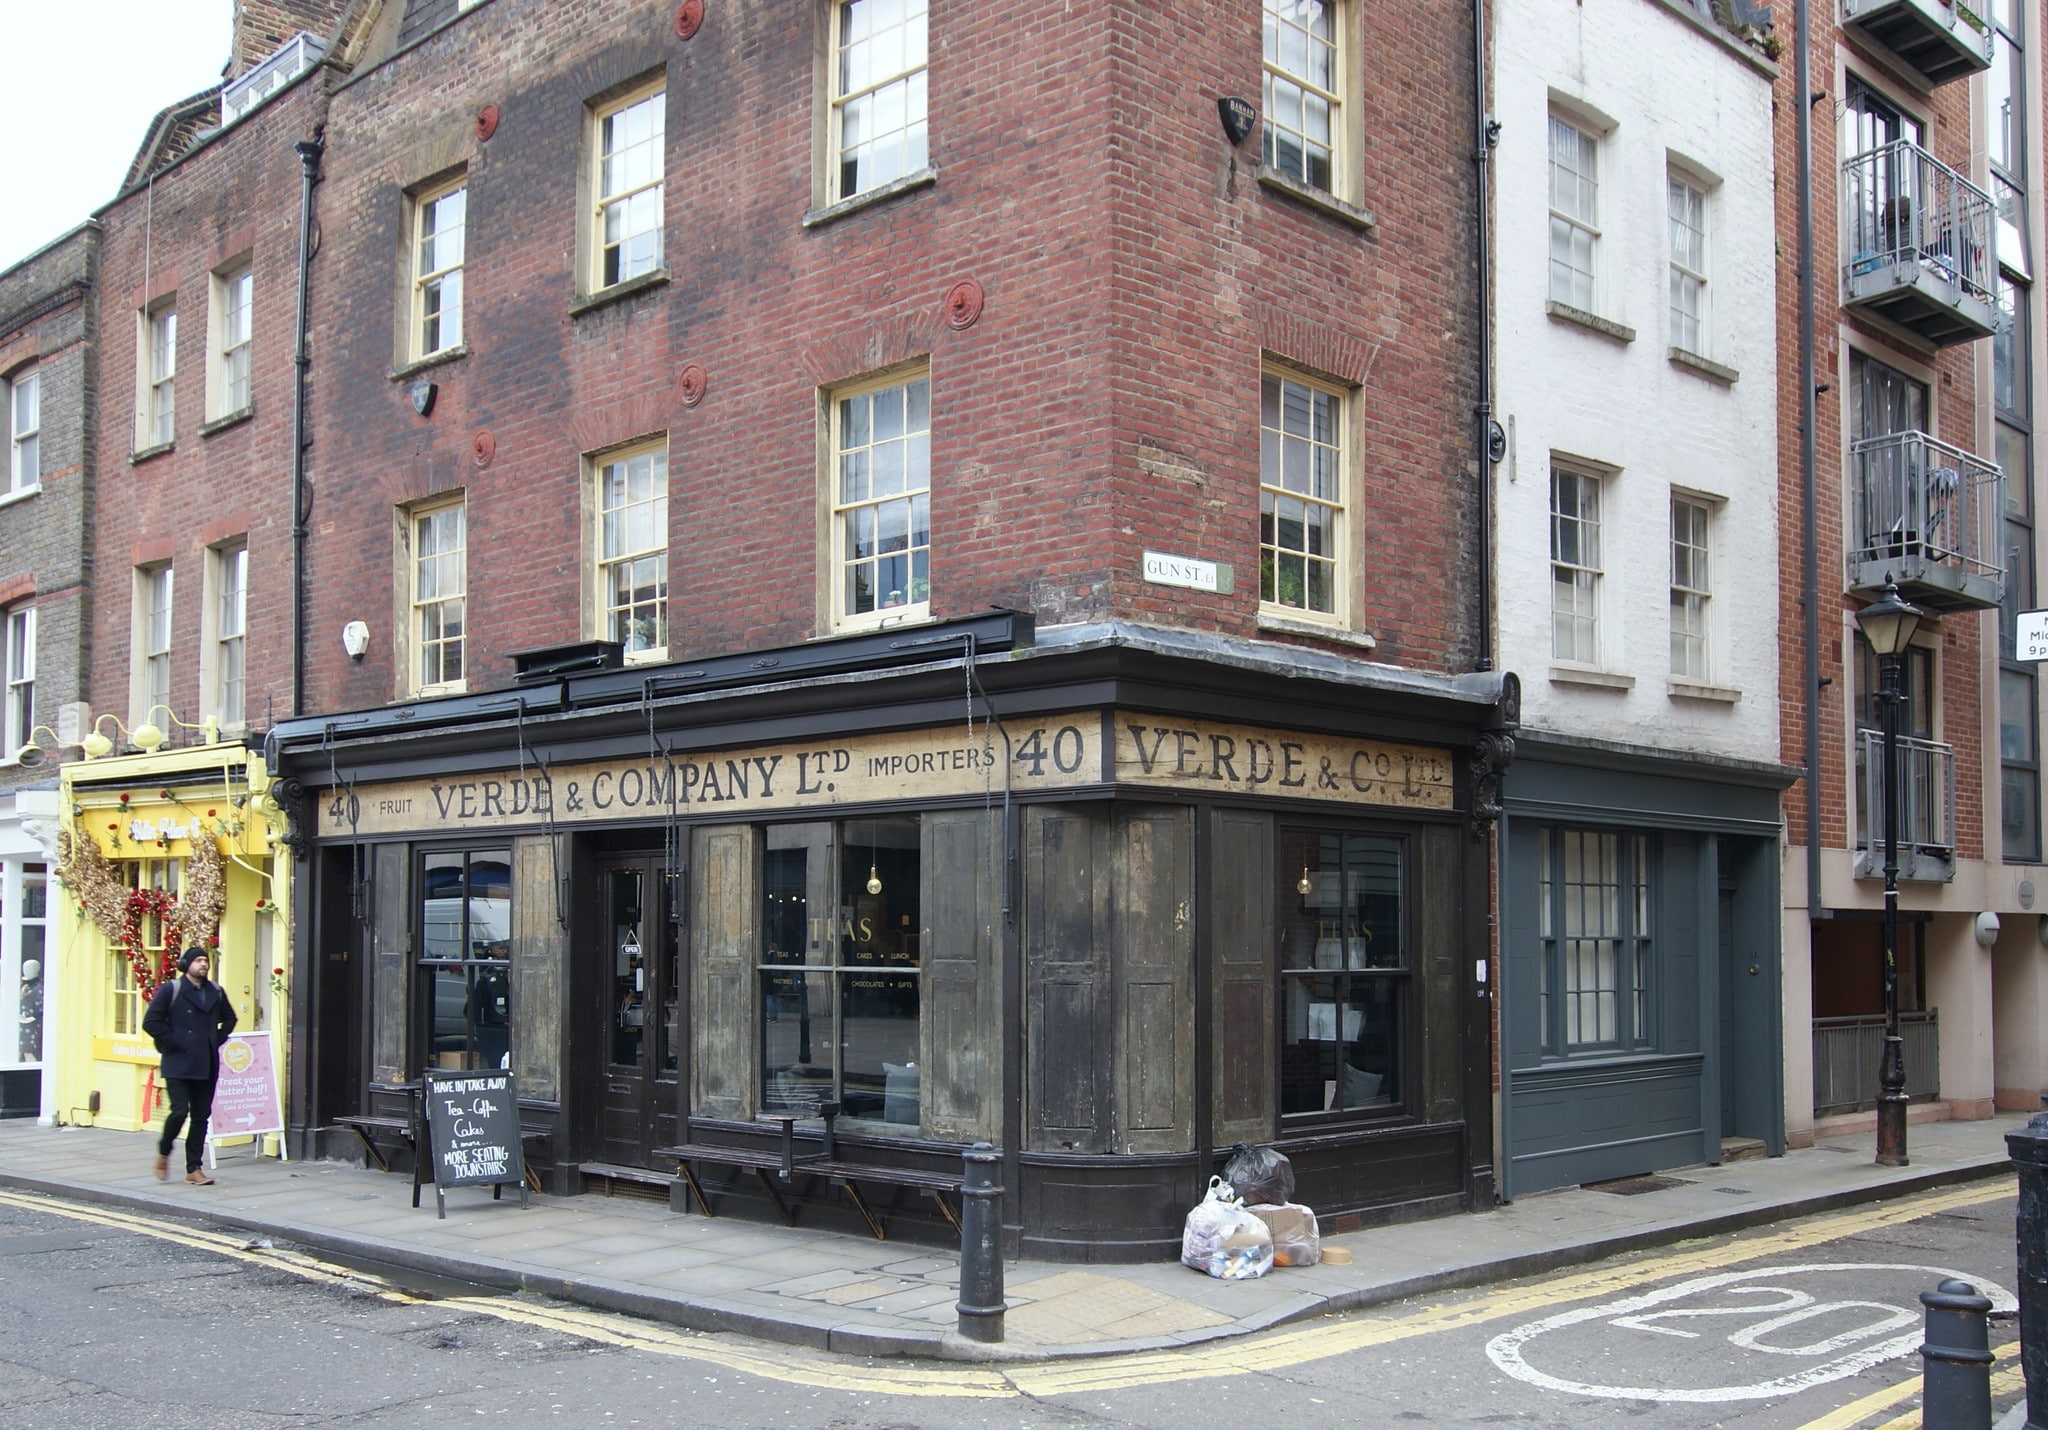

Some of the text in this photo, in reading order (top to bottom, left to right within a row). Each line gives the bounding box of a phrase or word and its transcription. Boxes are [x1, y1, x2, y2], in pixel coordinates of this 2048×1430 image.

[1147, 560, 1180, 577] GUN
[1184, 565, 1204, 582] ST.
[1016, 725, 1085, 777] 40
[1127, 724, 1308, 788] VERDE
[1317, 755, 1341, 791] &
[328, 794, 361, 828] 40
[379, 798, 413, 816] FRUIT
[431, 776, 552, 820] VERDE
[566, 781, 584, 813] &
[591, 755, 783, 811] COMPANY
[868, 746, 996, 778] IMPORTERS
[856, 952, 873, 960] CAKES
[891, 952, 910, 960] LUNCH
[898, 981, 913, 989] GIFTS
[218, 1076, 265, 1087] Treat your
[433, 1080, 455, 1094] HAVE
[487, 1077, 507, 1090] AWAY
[217, 1087, 246, 1096] butter
[444, 1100, 465, 1116] Tea
[453, 1118, 485, 1138] Cakes
[444, 1146, 509, 1166] MORE SEATING
[453, 1161, 507, 1179] DOWNSTAIRS
[1607, 1286, 1922, 1356] 20
